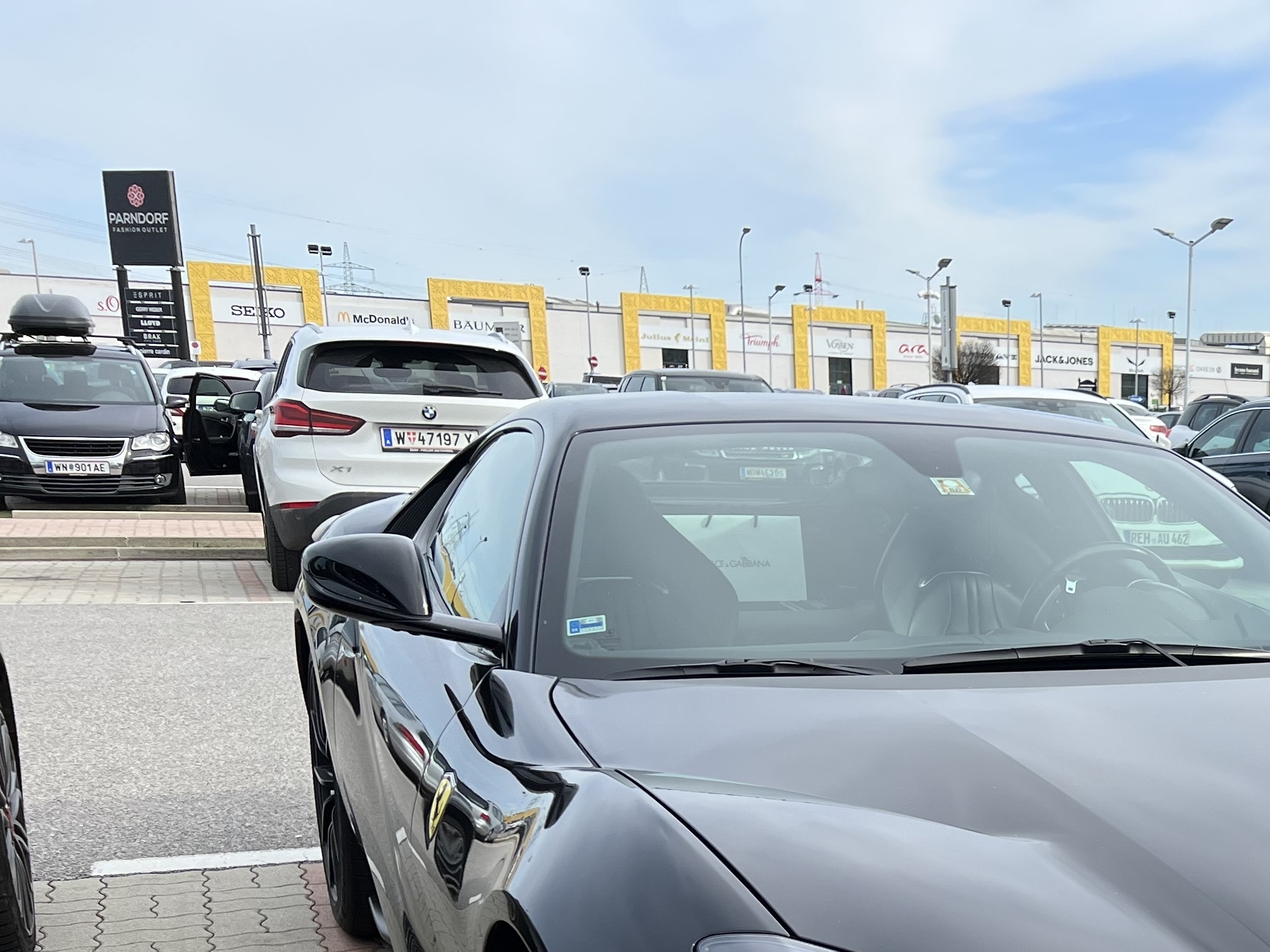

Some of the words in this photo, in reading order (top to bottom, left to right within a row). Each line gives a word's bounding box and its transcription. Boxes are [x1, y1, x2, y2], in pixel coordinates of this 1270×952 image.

[109, 212, 169, 225] PARNDORF
[133, 291, 162, 299] ESPRIT
[140, 319, 161, 327] LLOYD
[740, 333, 781, 351] Triumph
[395, 431, 406, 445] W
[418, 431, 460, 446] 47197
[464, 433, 473, 444] Y
[53, 463, 68, 472] WN
[1131, 532, 1151, 545] REH
[1157, 533, 1170, 545] AU
[1171, 533, 1189, 546] 462
